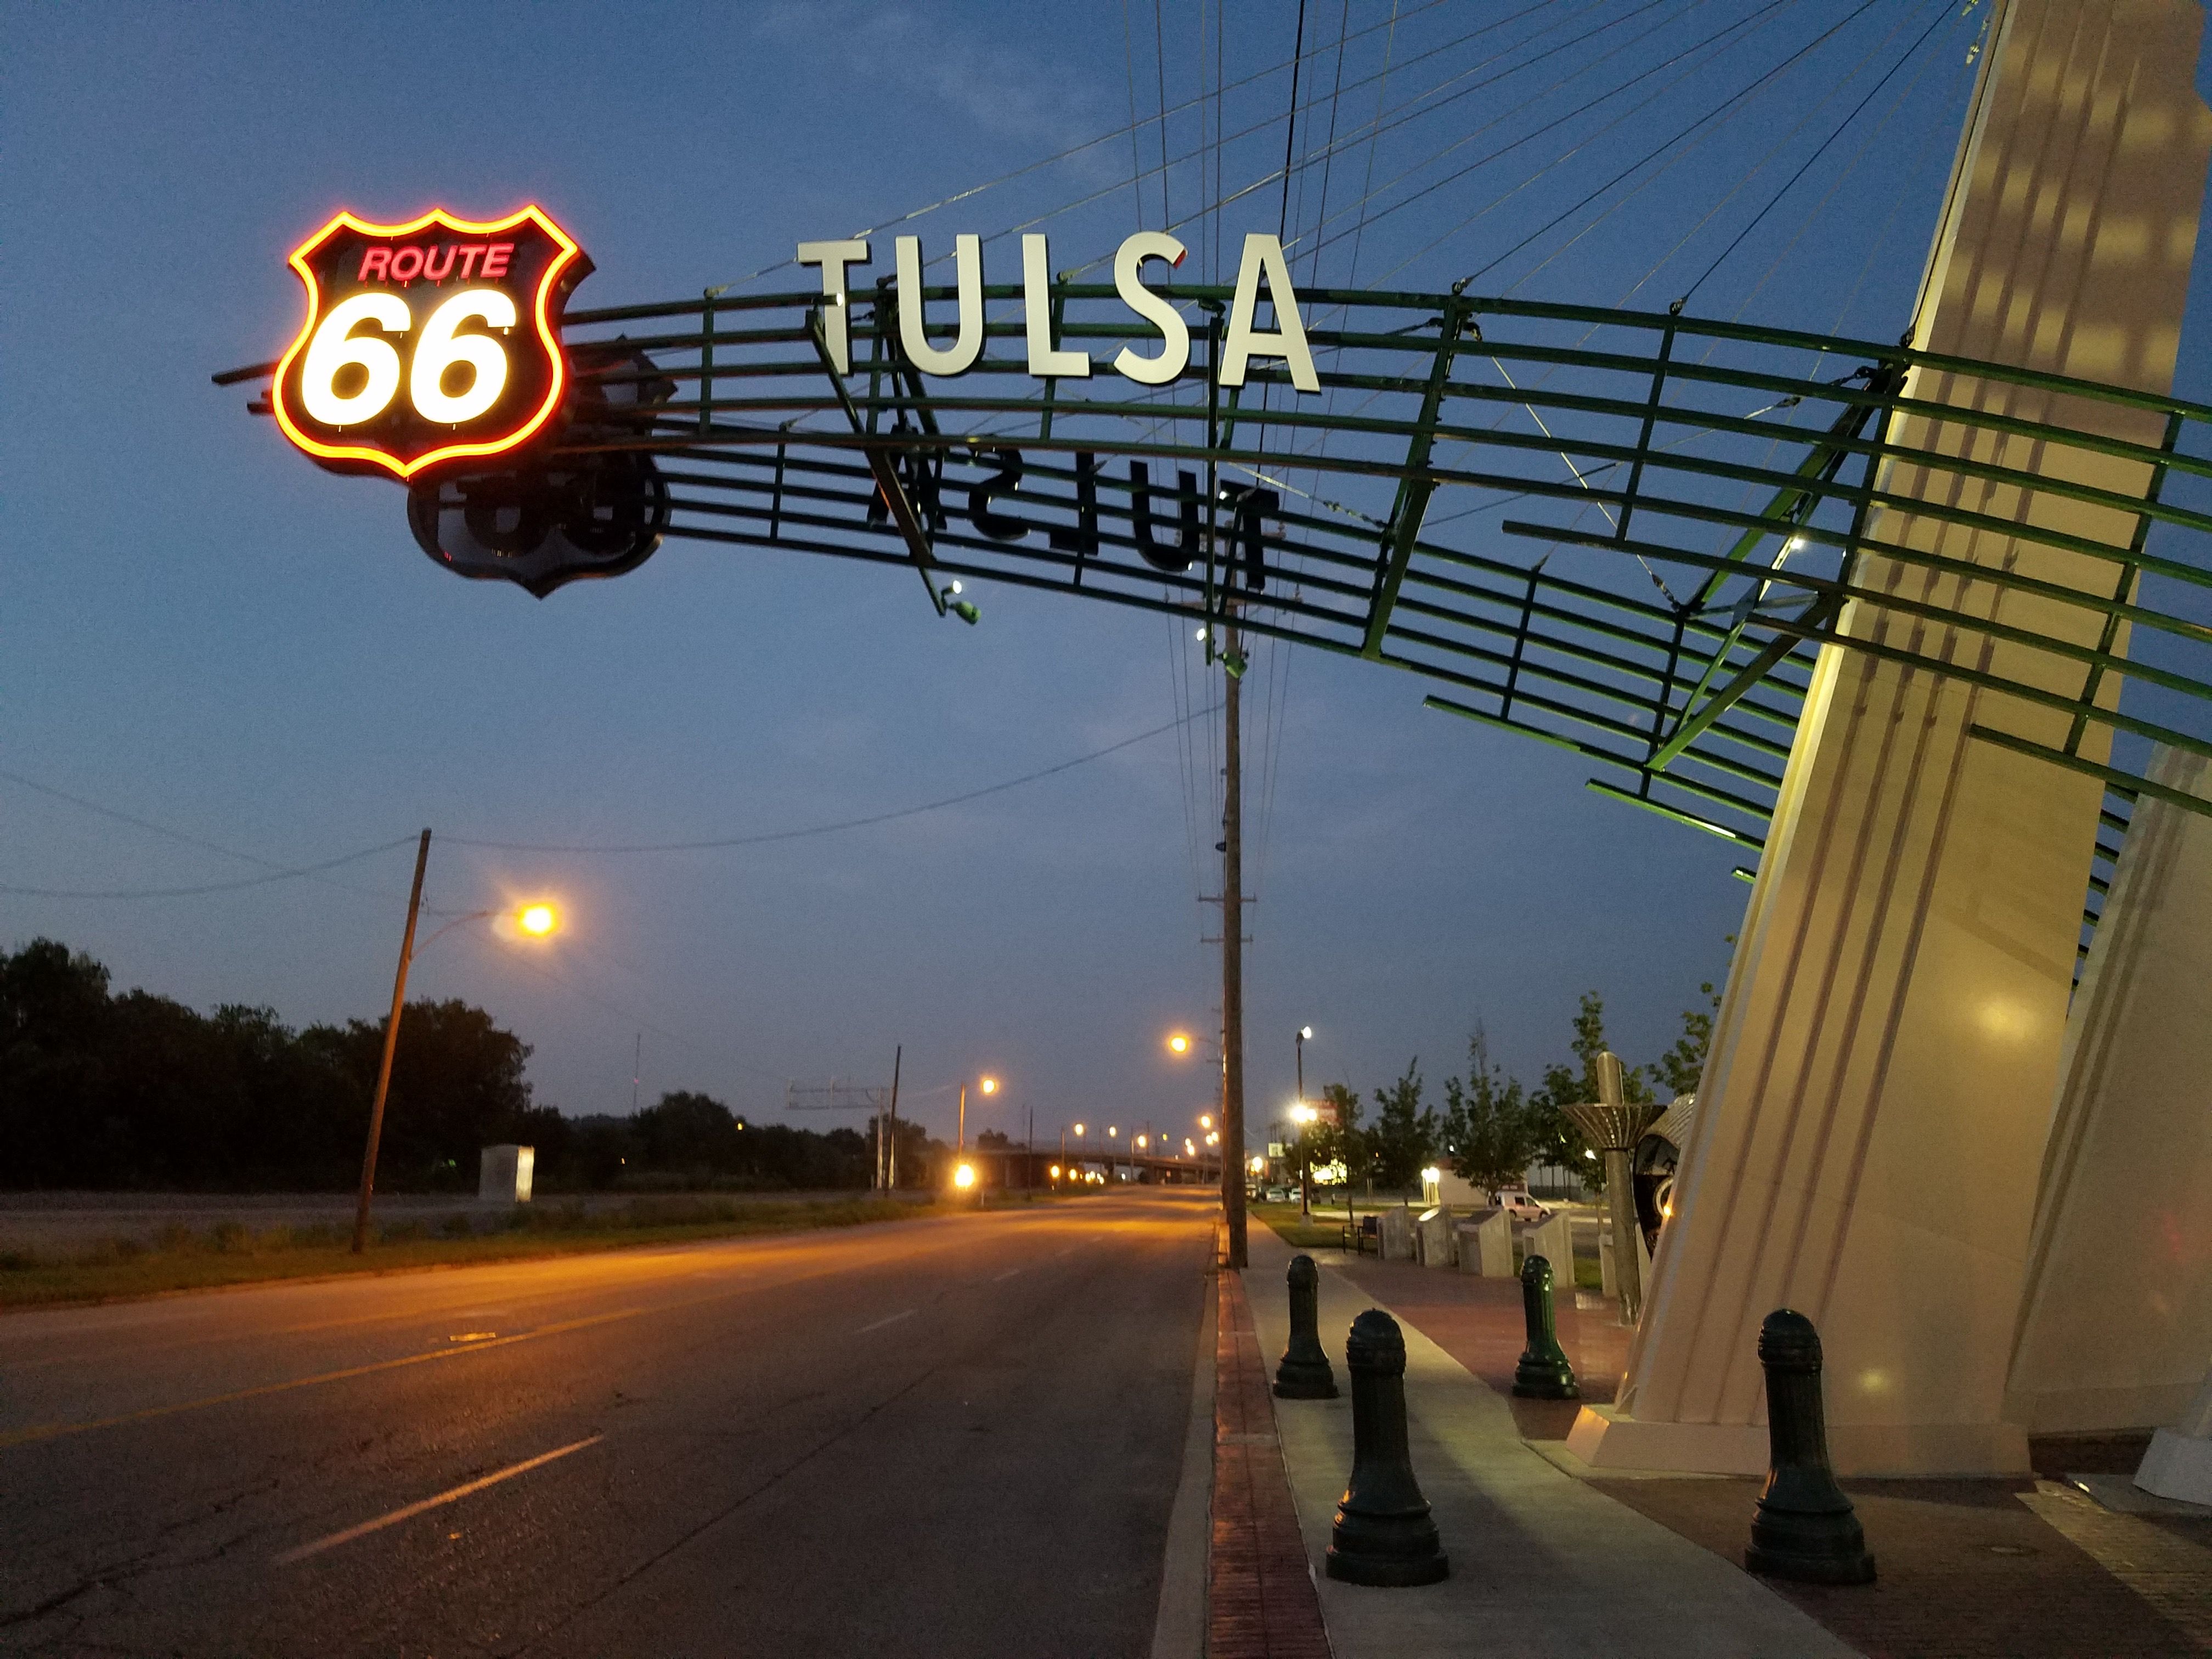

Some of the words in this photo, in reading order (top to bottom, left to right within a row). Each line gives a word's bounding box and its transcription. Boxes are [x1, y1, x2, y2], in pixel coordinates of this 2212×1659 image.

[358, 243, 515, 281] ROUTE
[797, 231, 1321, 393] TULSA
[302, 289, 516, 425] 66
